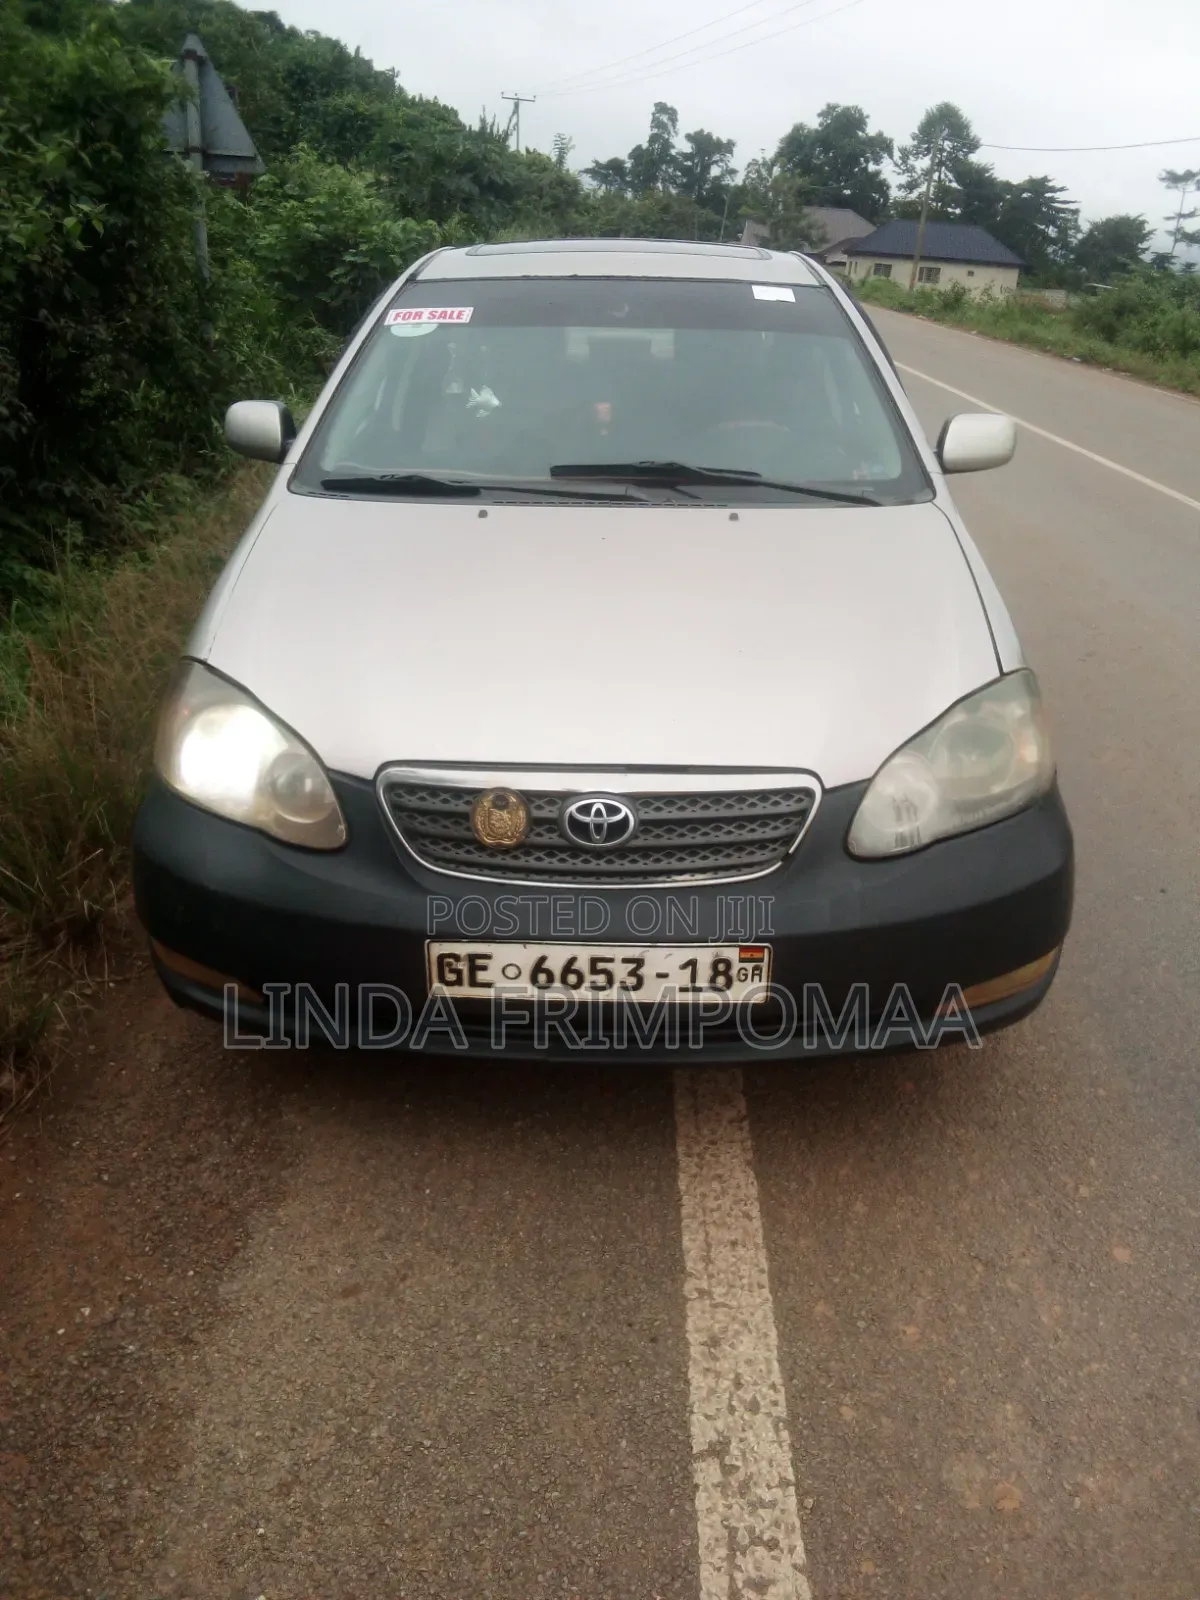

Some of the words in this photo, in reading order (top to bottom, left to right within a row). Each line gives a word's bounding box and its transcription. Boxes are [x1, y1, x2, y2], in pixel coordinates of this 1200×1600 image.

[393, 310, 424, 322] FOR
[427, 310, 466, 320] SALE
[437, 953, 495, 988] GE
